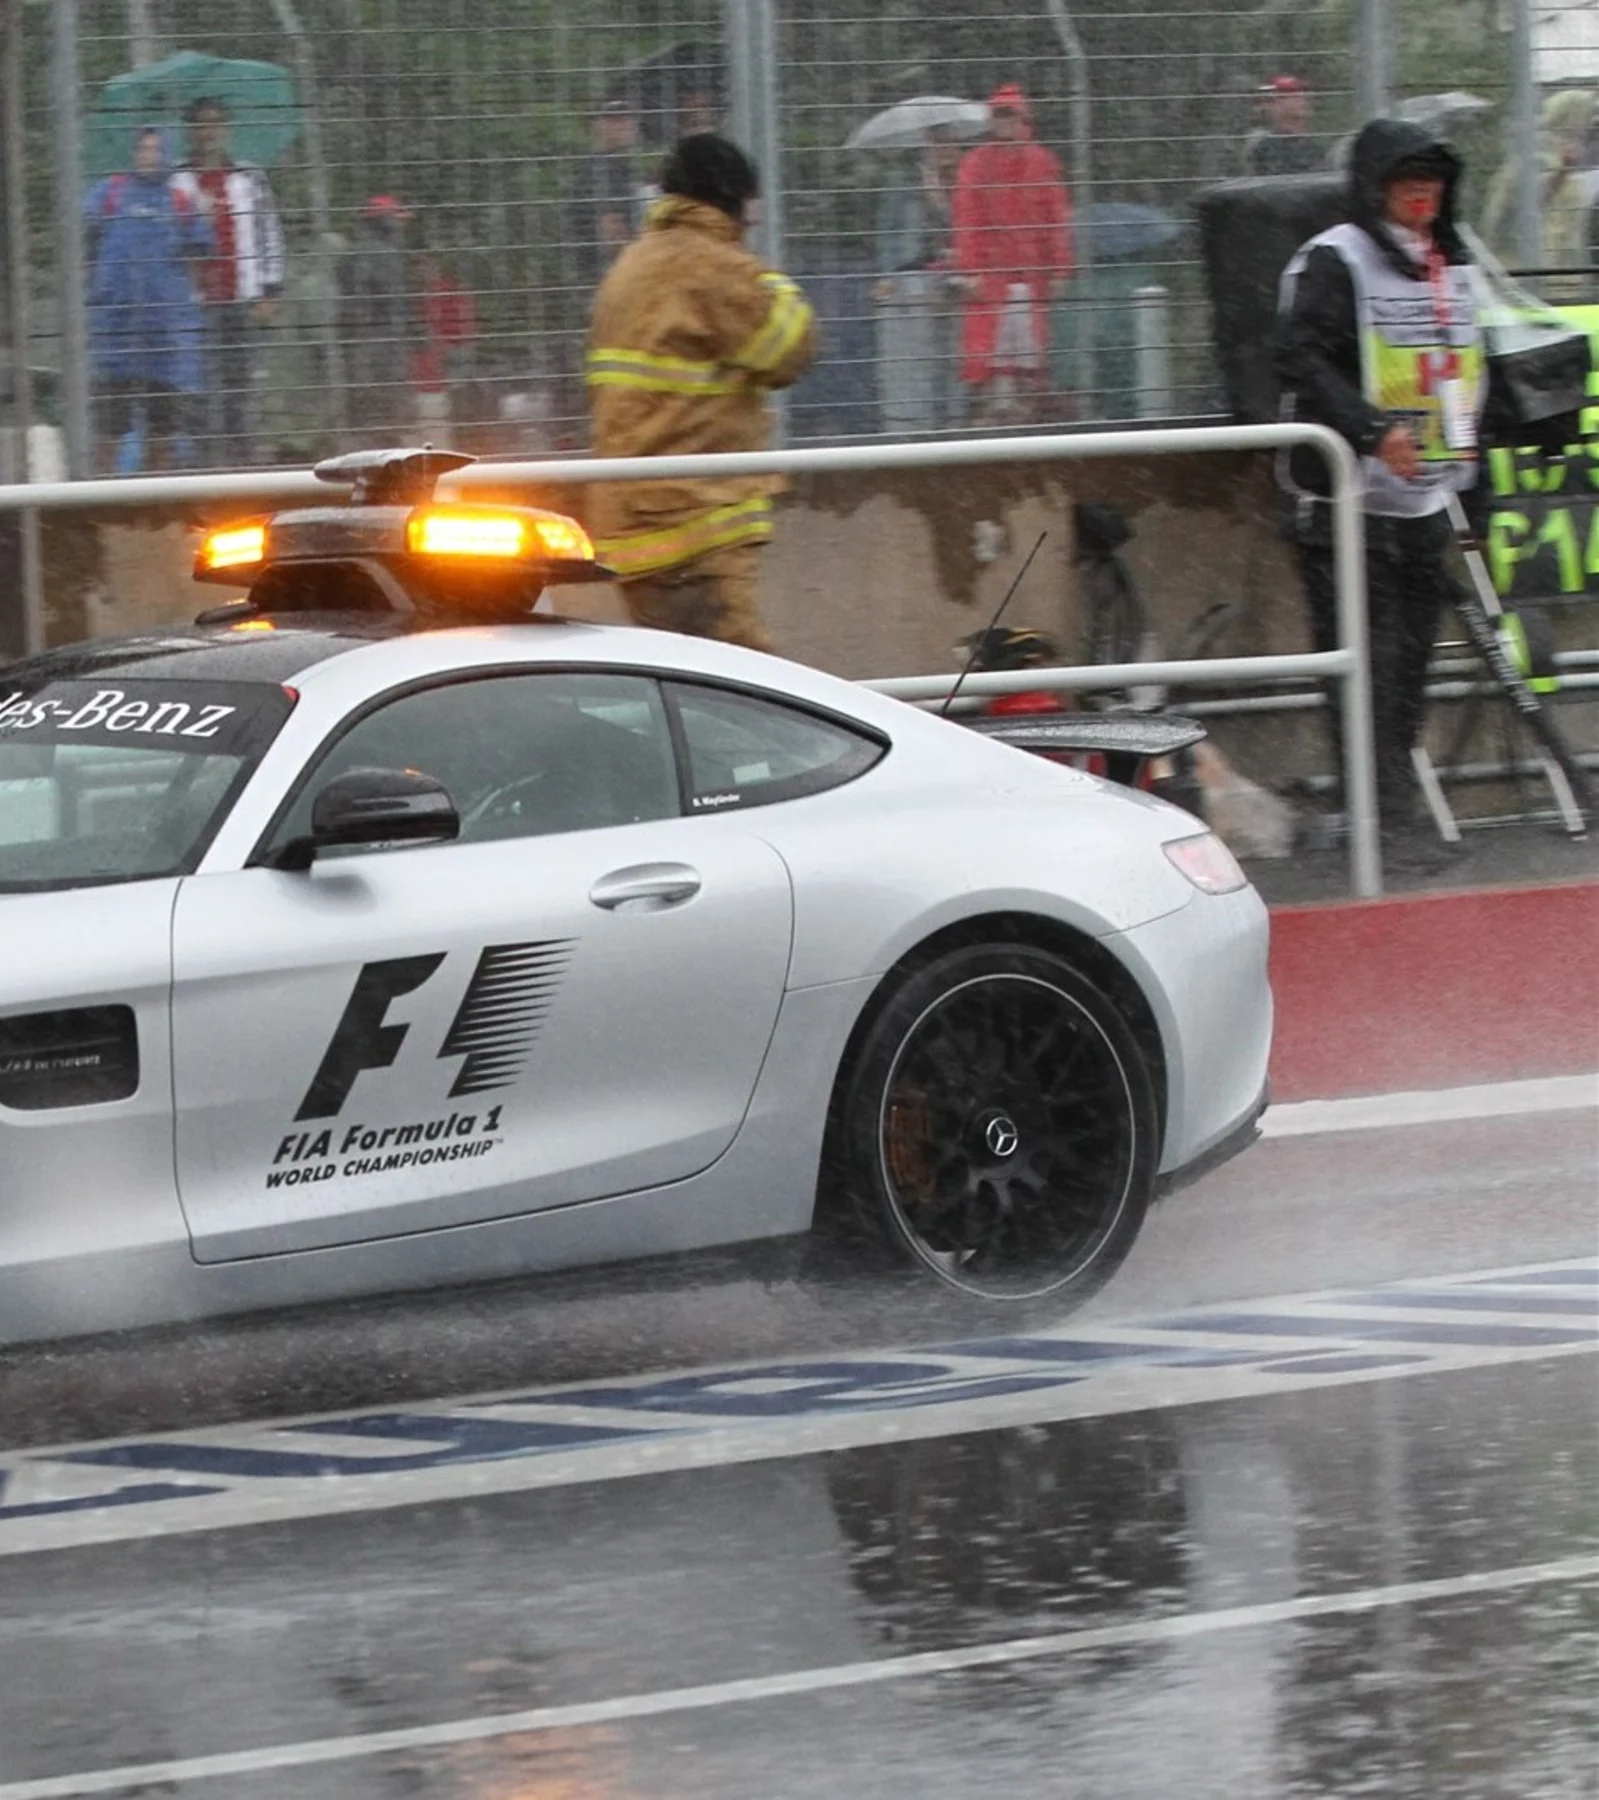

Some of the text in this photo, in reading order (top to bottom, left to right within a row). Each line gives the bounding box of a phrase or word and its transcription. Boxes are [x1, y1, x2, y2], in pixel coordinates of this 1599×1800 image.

[273, 1104, 503, 1164] FIA Formula 1
[265, 1139, 494, 1189] WORLD CHAMPIONSHIP
